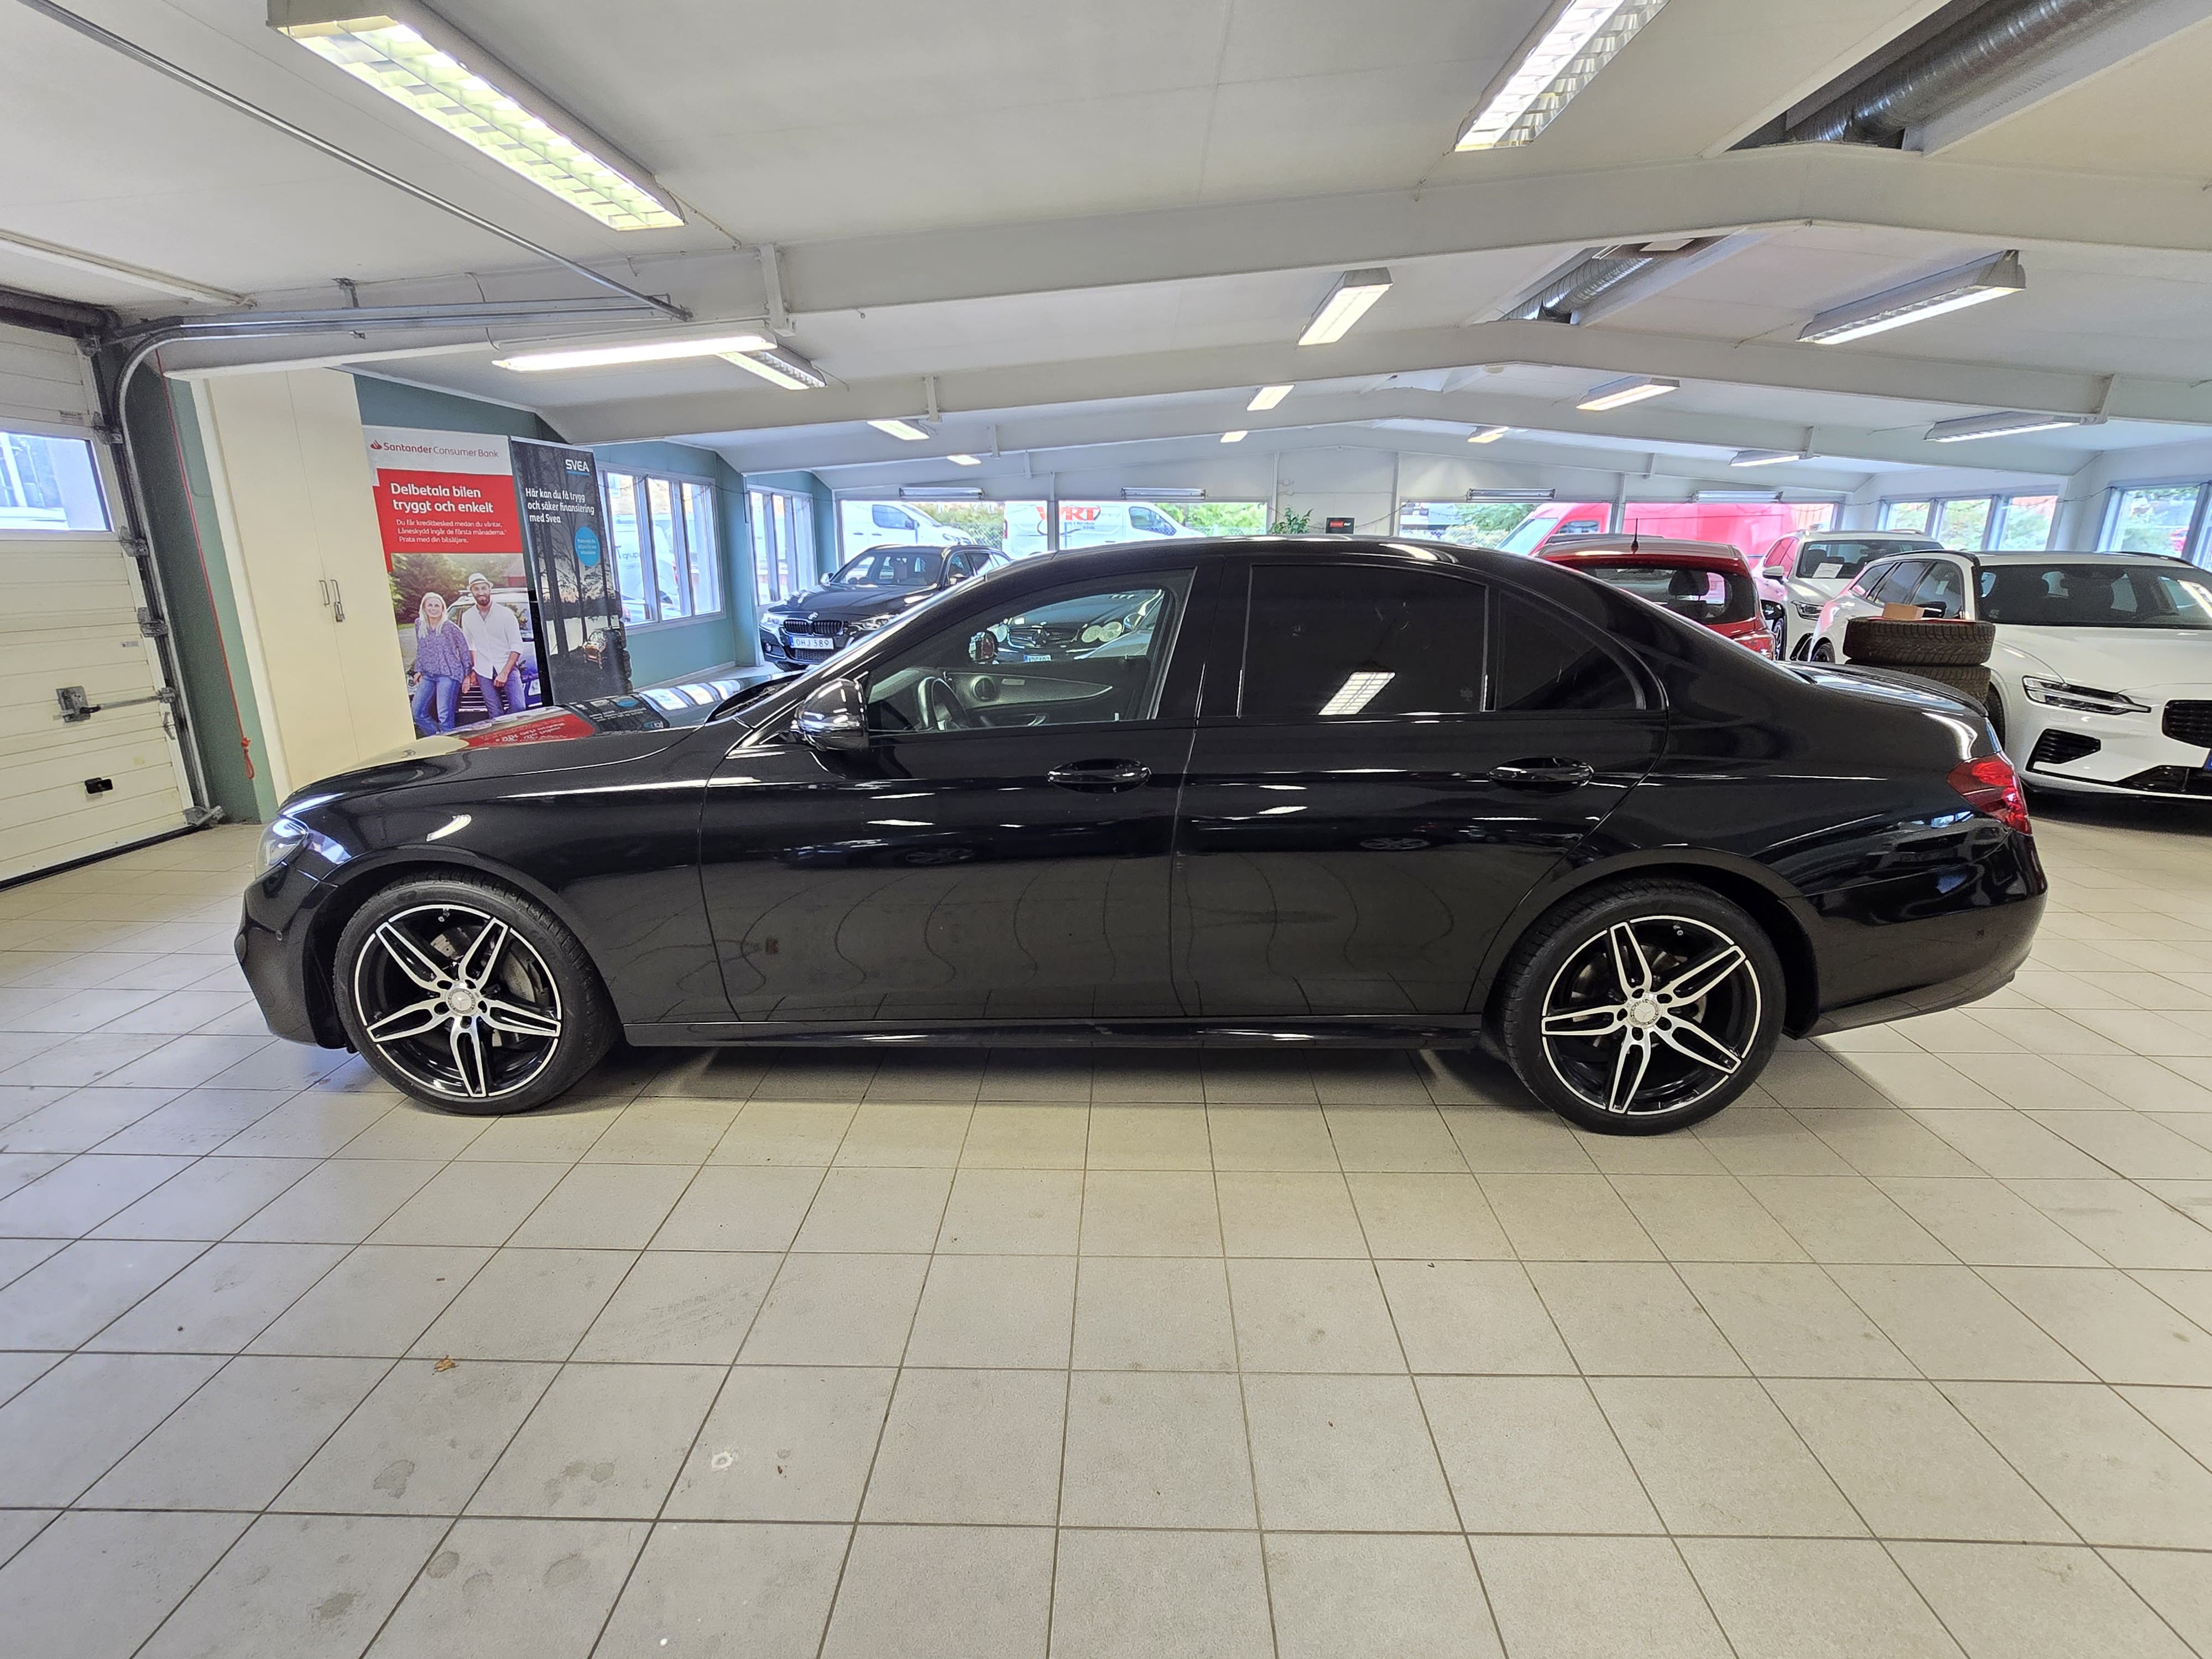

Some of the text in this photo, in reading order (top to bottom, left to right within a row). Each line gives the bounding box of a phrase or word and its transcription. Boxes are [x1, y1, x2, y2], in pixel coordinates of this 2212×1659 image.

[384, 442, 498, 457] Santander Consumer Bank
[565, 459, 589, 472] SVEA
[390, 483, 481, 498] Delbetala bilen
[525, 487, 585, 503] Här kan du få trygg
[393, 499, 494, 514] tryggt och enkelt
[528, 500, 594, 515] och säker finansiering
[529, 513, 561, 523] med Svea
